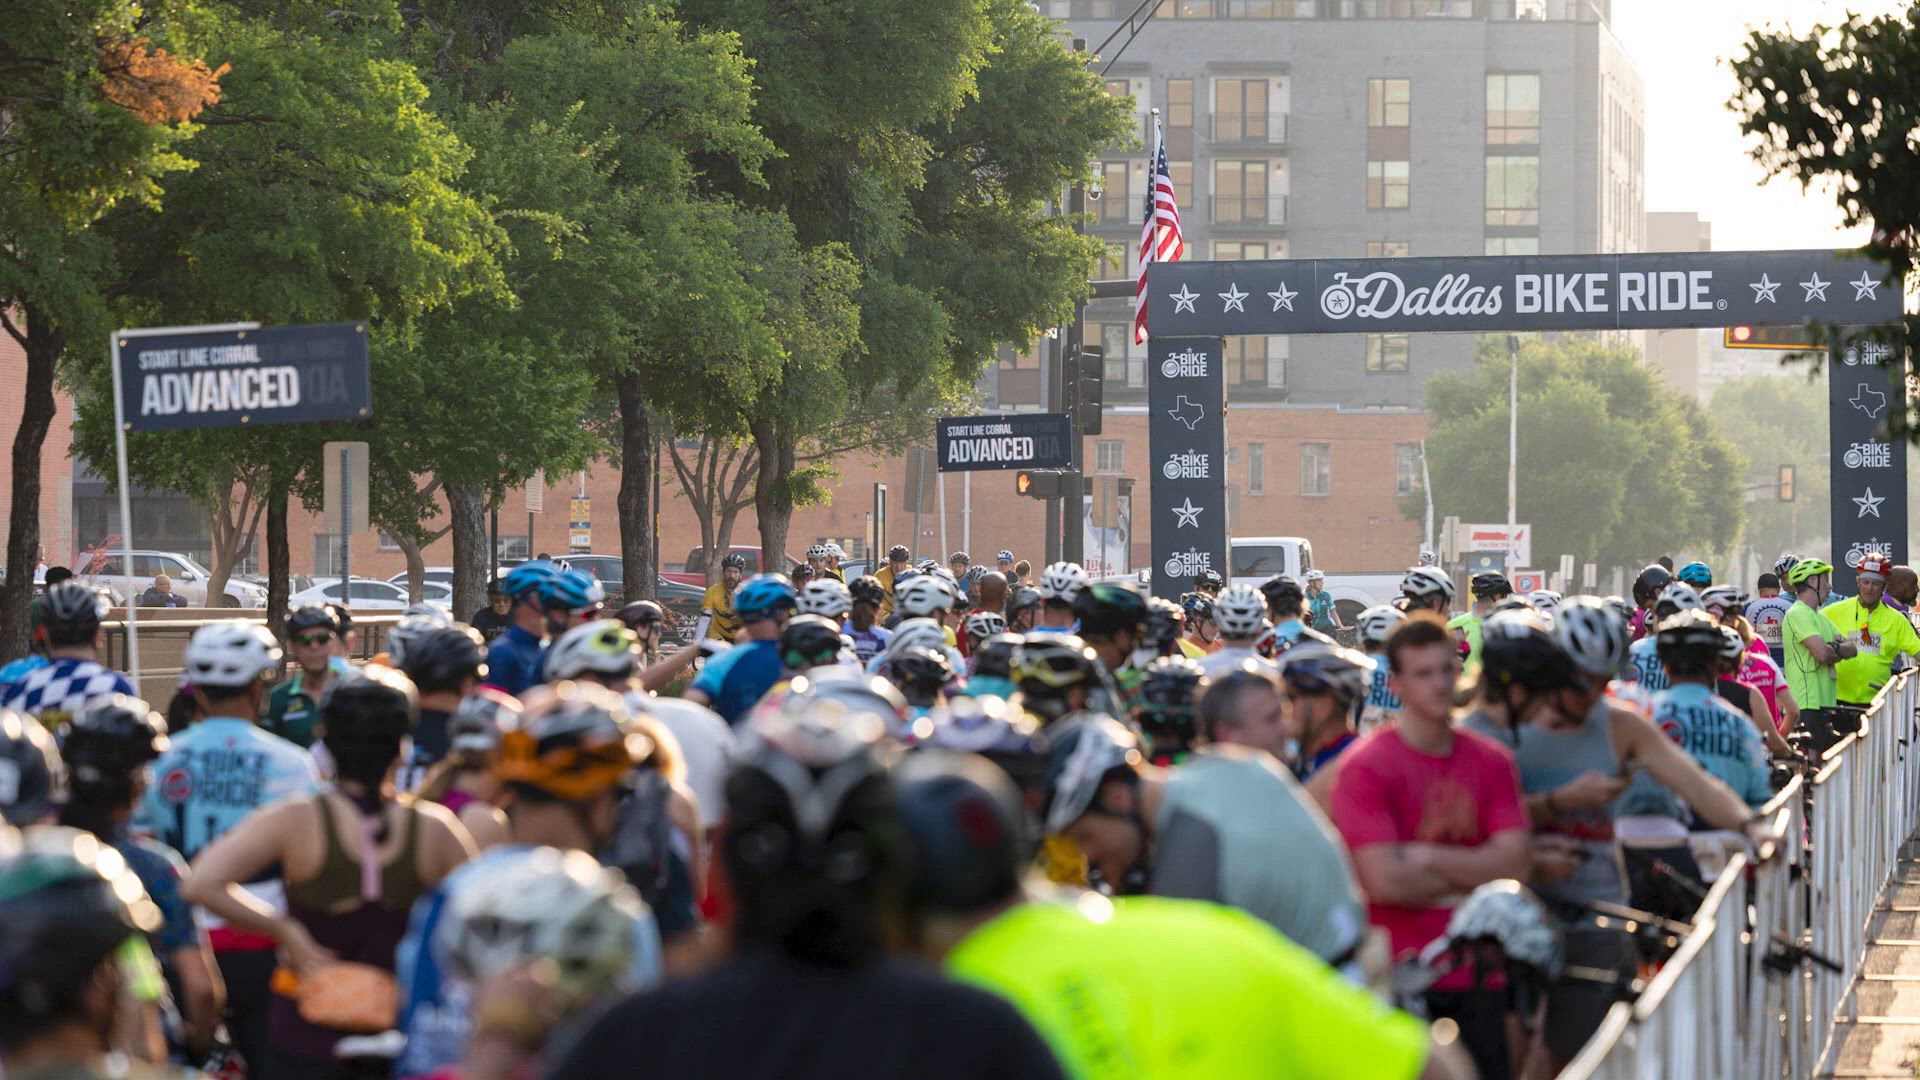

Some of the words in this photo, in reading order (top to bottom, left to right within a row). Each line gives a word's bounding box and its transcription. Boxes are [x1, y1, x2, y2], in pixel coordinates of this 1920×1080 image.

[1354, 271, 1502, 319] Dallas
[1516, 272, 1609, 314] BIKE
[138, 349, 180, 370] START
[181, 347, 209, 368] LINE
[210, 344, 262, 365] CORRAL
[1180, 353, 1207, 365] BIKE
[1180, 365, 1208, 377] RIDE
[141, 365, 300, 416] ADVANCED
[947, 425, 969, 437] START
[970, 424, 985, 436] LINE
[986, 423, 1013, 435] CORRAL
[948, 436, 1034, 464] ADVANCED
[1863, 443, 1890, 455] BIKE
[1181, 454, 1209, 466] BIKE
[1863, 455, 1890, 467] RIDE
[1181, 466, 1209, 478] RIDE
[1863, 543, 1892, 555] BIKE
[1183, 552, 1210, 564] BIKE
[1691, 730, 1748, 763] RIDE
[202, 749, 269, 776] BIKE
[201, 778, 266, 809] RIDE
